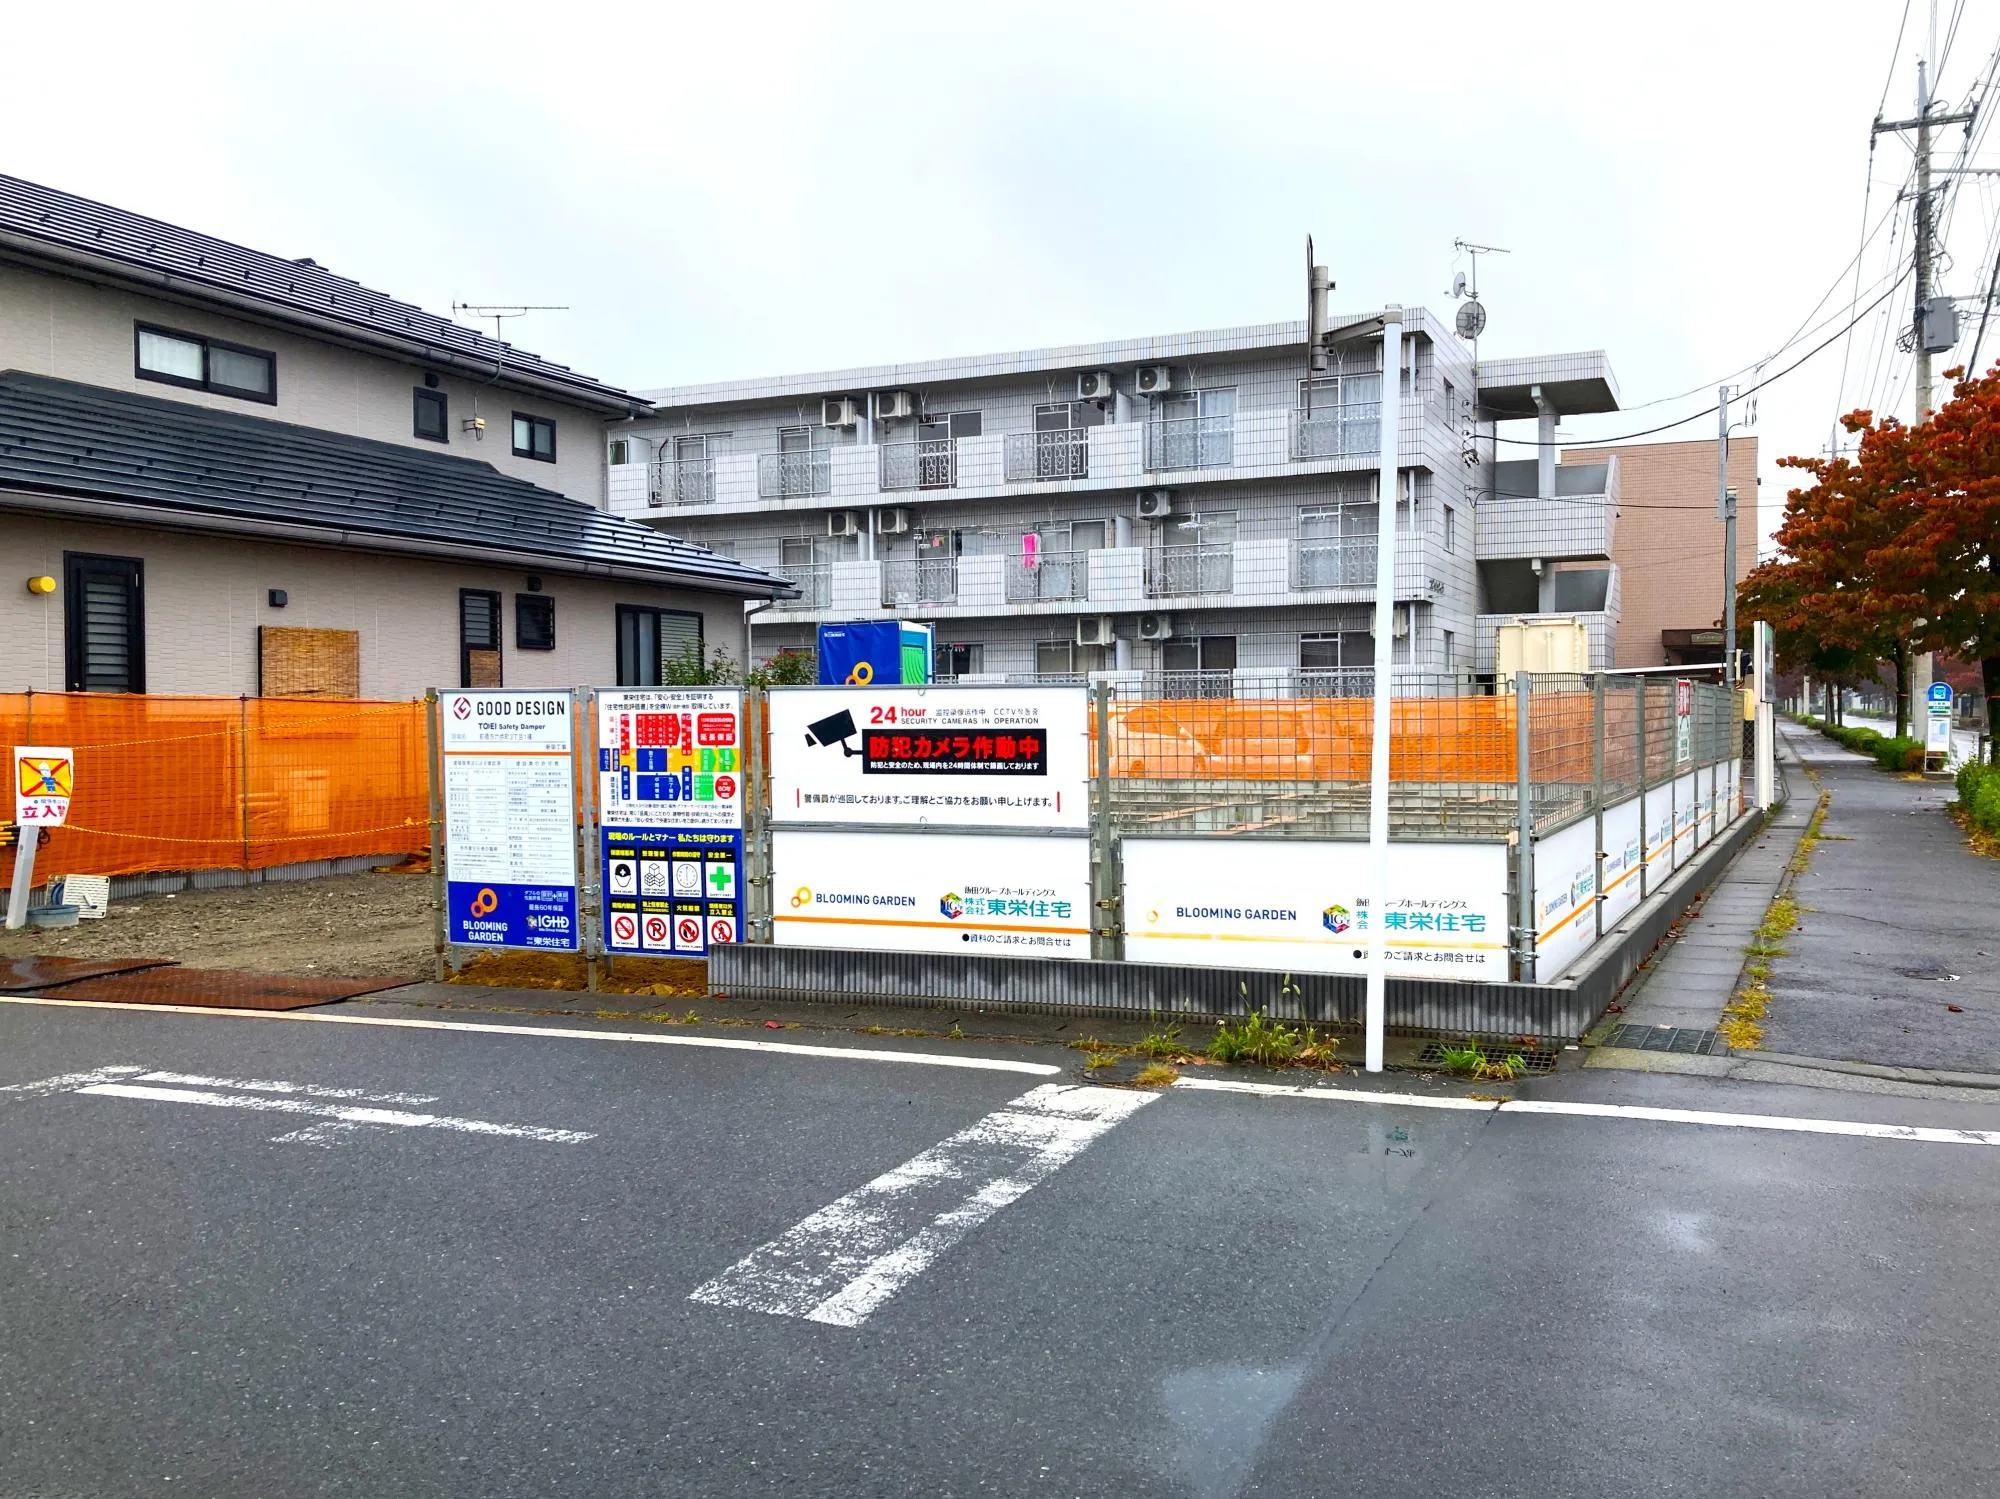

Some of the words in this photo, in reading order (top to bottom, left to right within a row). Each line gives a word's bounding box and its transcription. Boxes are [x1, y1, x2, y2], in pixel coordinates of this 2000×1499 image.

[477, 701, 511, 716] GOOD
[516, 701, 565, 715] DESIGN
[870, 706, 897, 724] 24
[901, 706, 926, 716] hour
[499, 723, 518, 732] Safety
[869, 735, 1039, 760] 防犯カメラ作動中
[804, 793, 1052, 808] 警備員が巡回しております。ご理解とご協力をお願い申し上げます。
[816, 894, 870, 904] BLOOMING
[872, 895, 916, 906] GARDEN
[964, 898, 986, 906] 株式
[965, 907, 986, 916] 会社
[986, 898, 1072, 918] 東栄住宅
[1176, 906, 1242, 919] BLOOMING
[1245, 908, 1296, 920] GARDEN
[463, 920, 508, 932] BLOOMING
[1384, 912, 1486, 932] 東栄住宅
[468, 932, 504, 942] GARDEN
[970, 934, 1071, 946] 資料のご請求とお問合せは
